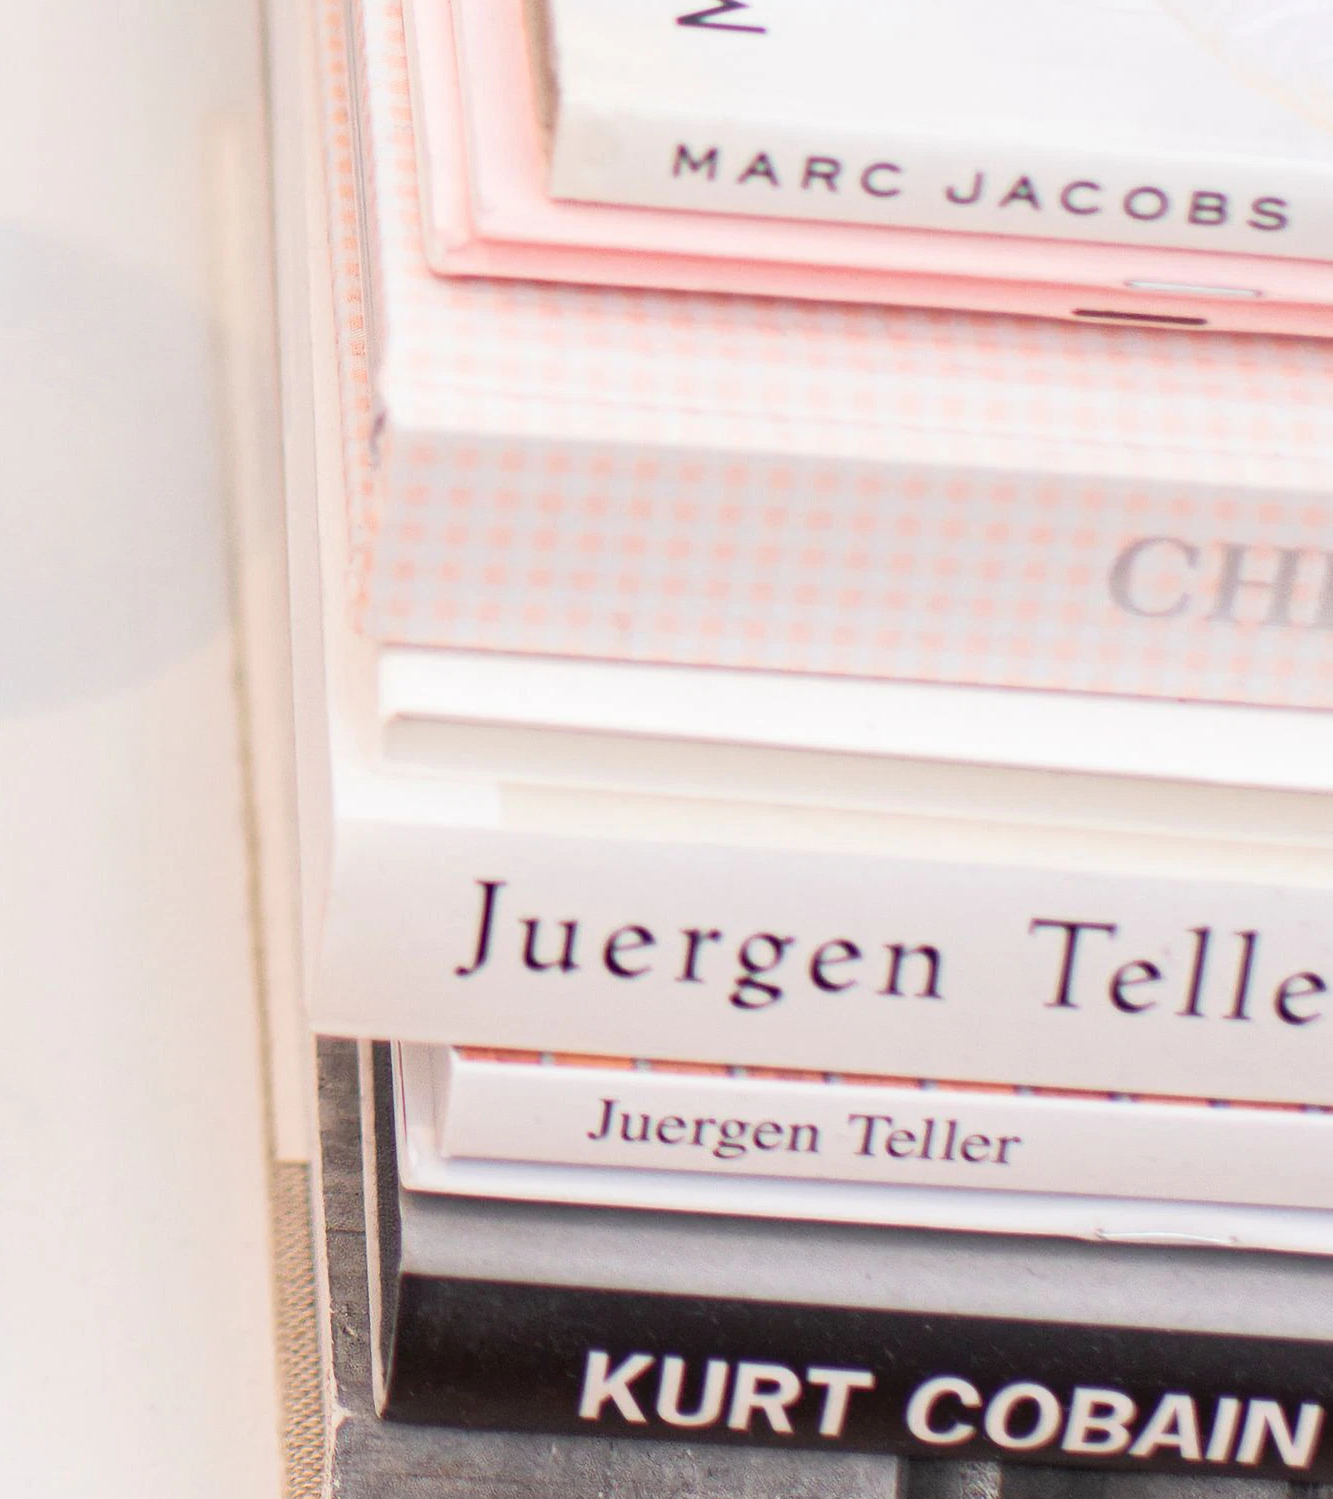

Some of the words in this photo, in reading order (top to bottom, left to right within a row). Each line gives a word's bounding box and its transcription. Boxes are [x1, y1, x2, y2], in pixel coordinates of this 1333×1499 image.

[670, 142, 904, 199] MARC
[944, 170, 1291, 235] JACOBS
[454, 878, 947, 1011] Juergen
[586, 1097, 821, 1162] Juergen
[848, 1113, 1023, 1168] Teller
[578, 1349, 875, 1437] KURT
[905, 1377, 1327, 1469] COBAIN
